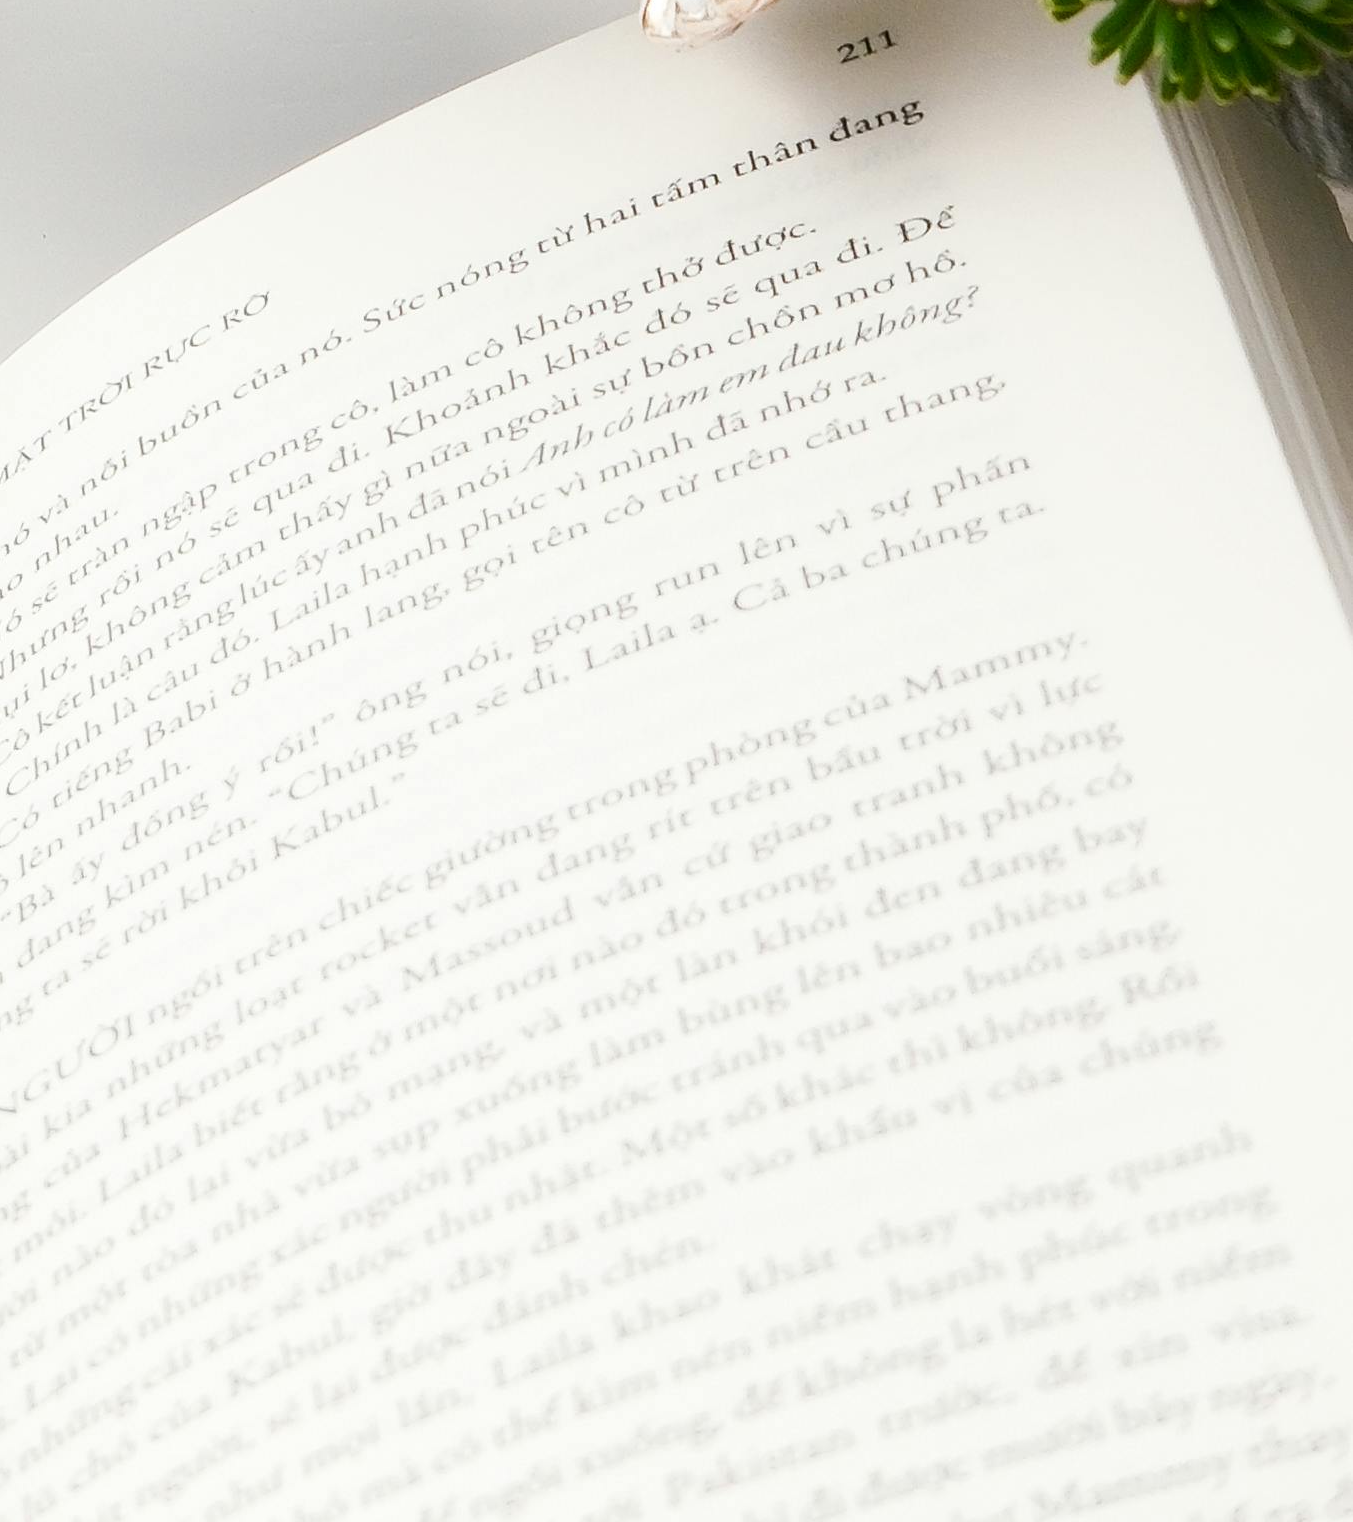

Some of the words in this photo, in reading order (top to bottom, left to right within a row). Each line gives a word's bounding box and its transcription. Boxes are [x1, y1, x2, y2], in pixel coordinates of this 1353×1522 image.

[836, 29, 899, 65] 211
[582, 197, 639, 236] hai
[252, 472, 314, 516] qua
[754, 260, 822, 299] qua
[228, 425, 324, 484] trong
[34, 508, 119, 573] nhau.
